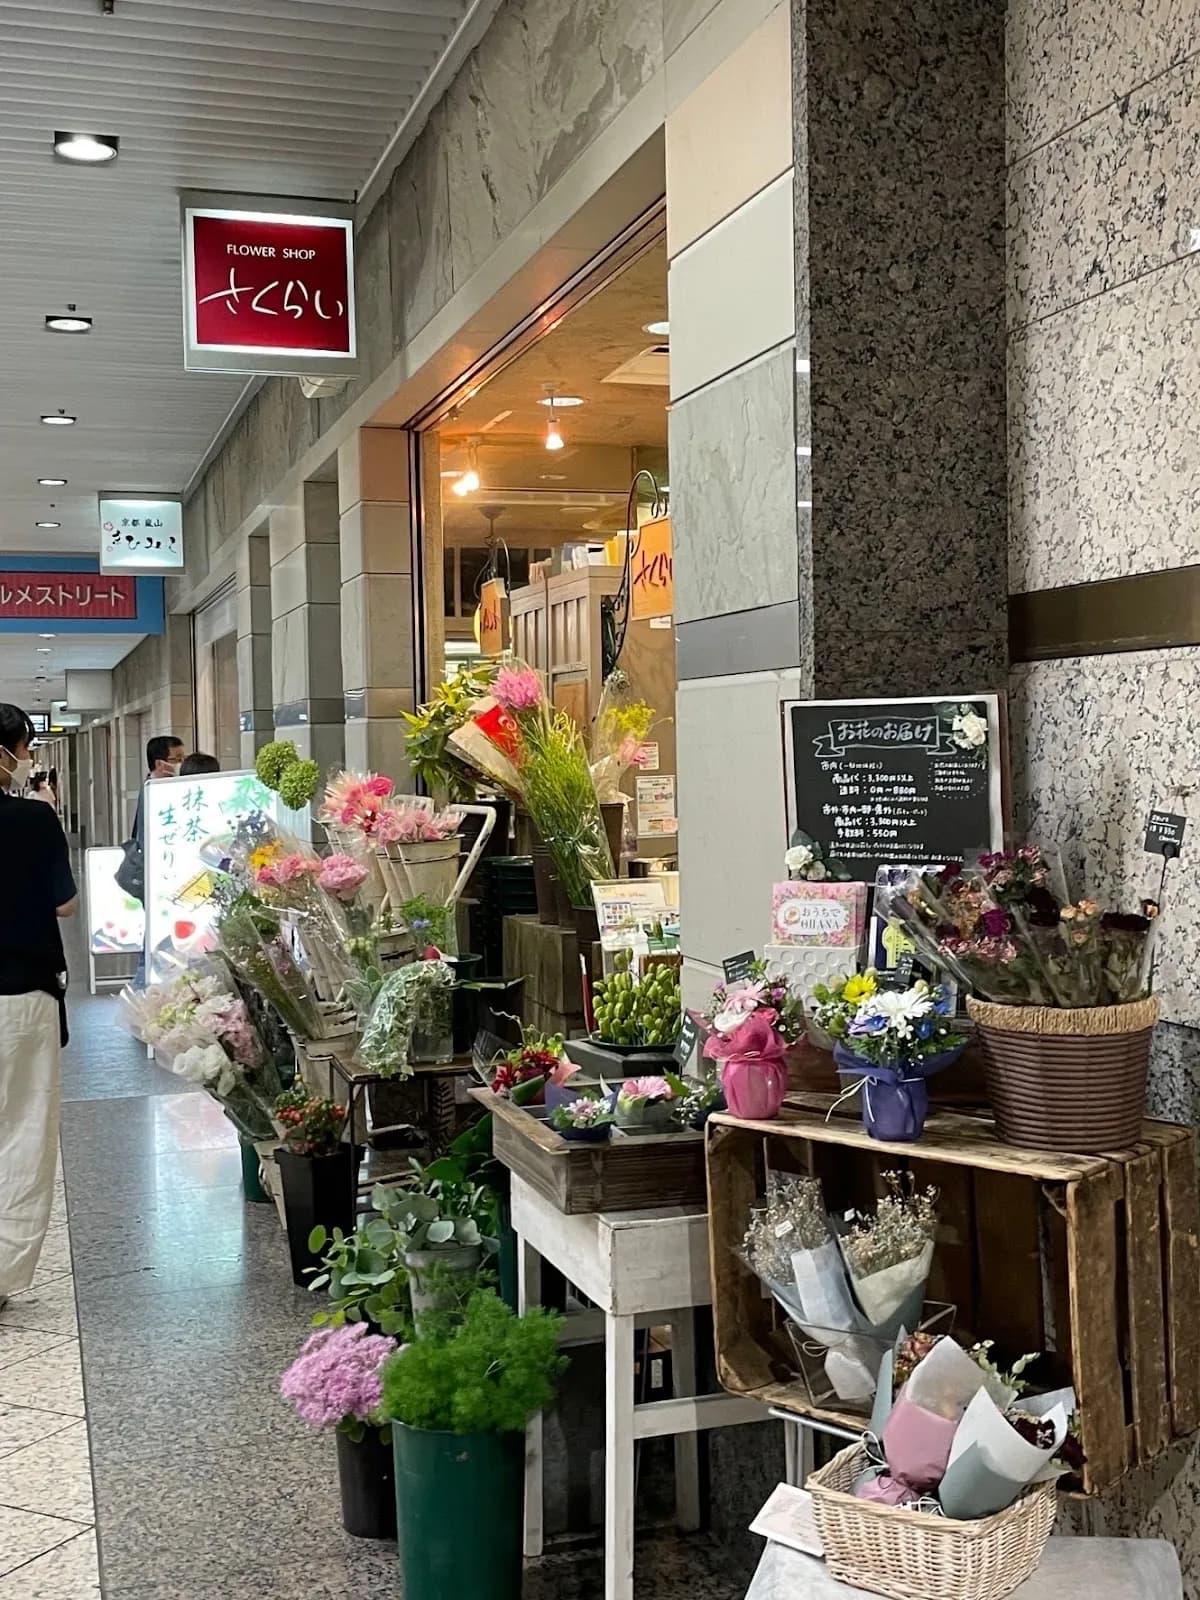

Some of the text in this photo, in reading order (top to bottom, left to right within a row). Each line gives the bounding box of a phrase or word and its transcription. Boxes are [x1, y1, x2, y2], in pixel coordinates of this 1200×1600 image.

[226, 243, 316, 260] FLOWER SHOP
[198, 267, 344, 319] さくらい
[121, 517, 164, 529] 京都 嵐山
[0, 585, 125, 607] ルメストリート
[837, 720, 934, 742] お花のお届け
[181, 785, 209, 842] 抹茶
[801, 906, 841, 918] おうちで
[800, 918, 841, 930] OHANA
